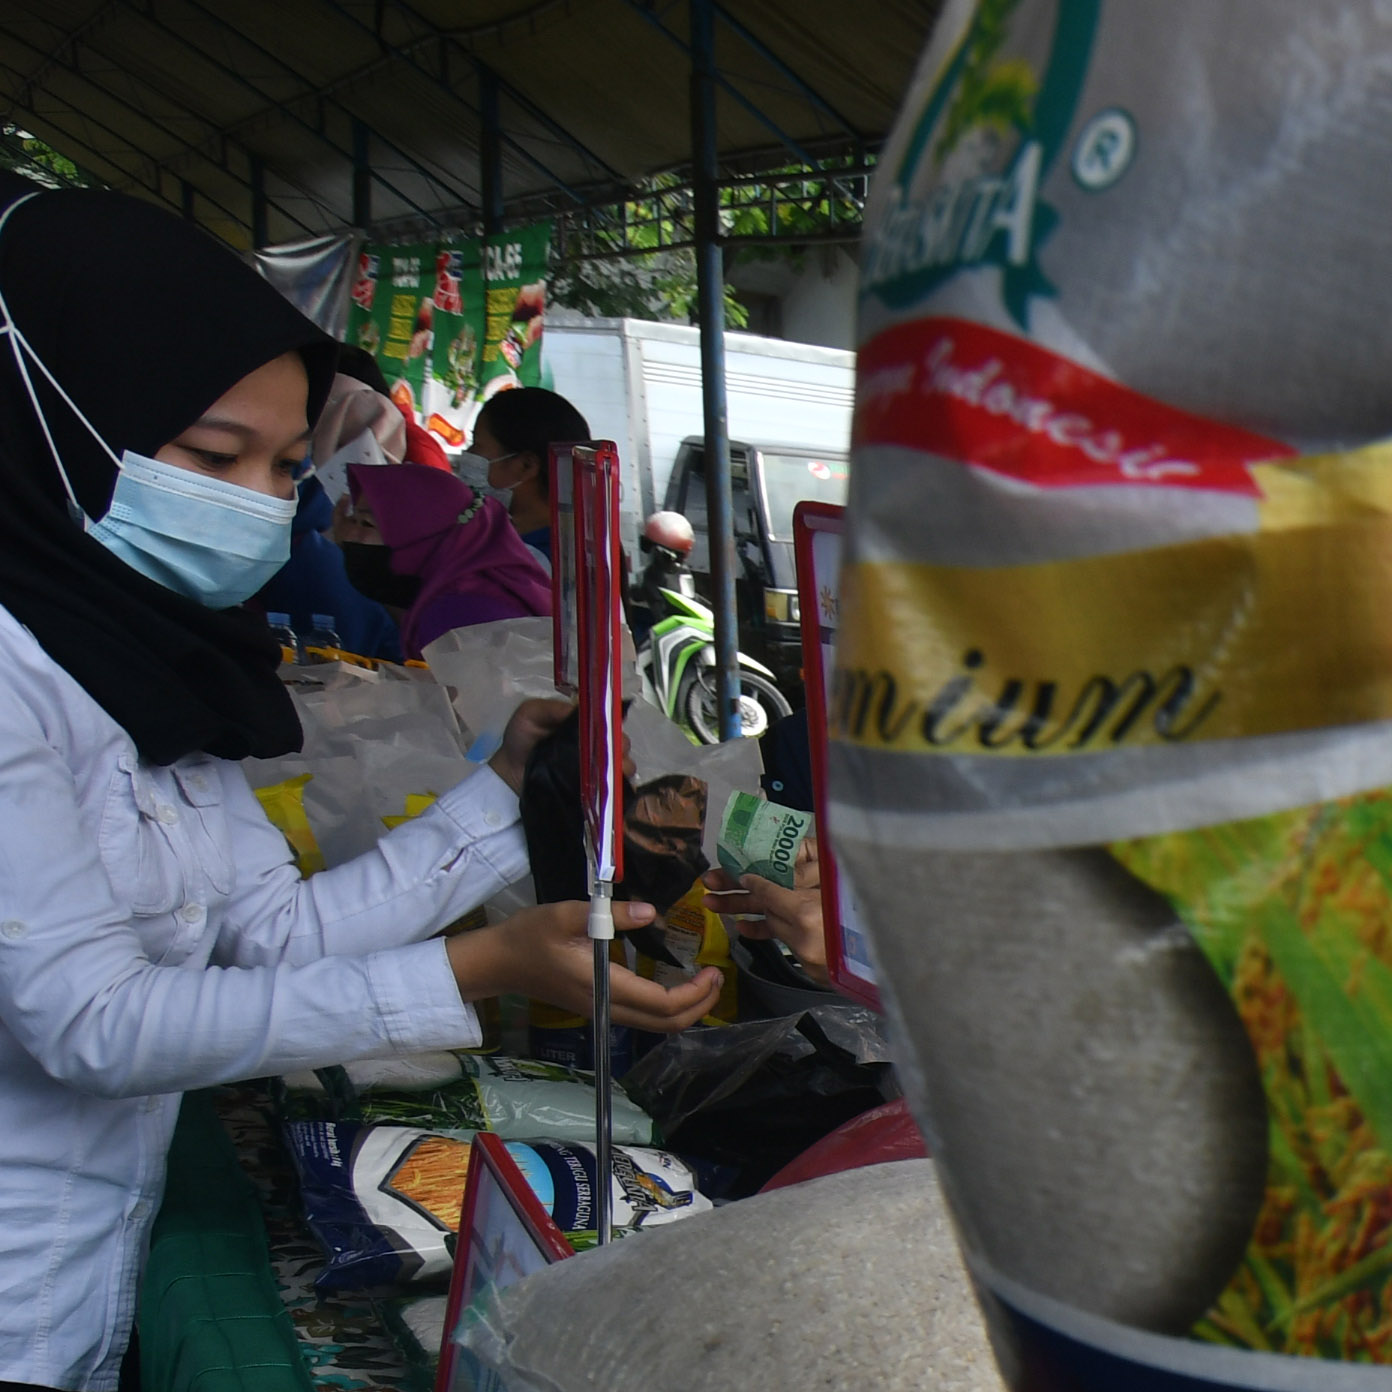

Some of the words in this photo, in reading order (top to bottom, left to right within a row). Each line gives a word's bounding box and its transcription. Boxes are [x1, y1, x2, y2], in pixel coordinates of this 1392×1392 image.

[773, 814, 805, 874] 20000
[563, 1156, 583, 1183] TERIGU
[571, 1182, 593, 1231] SERBAGUNA
